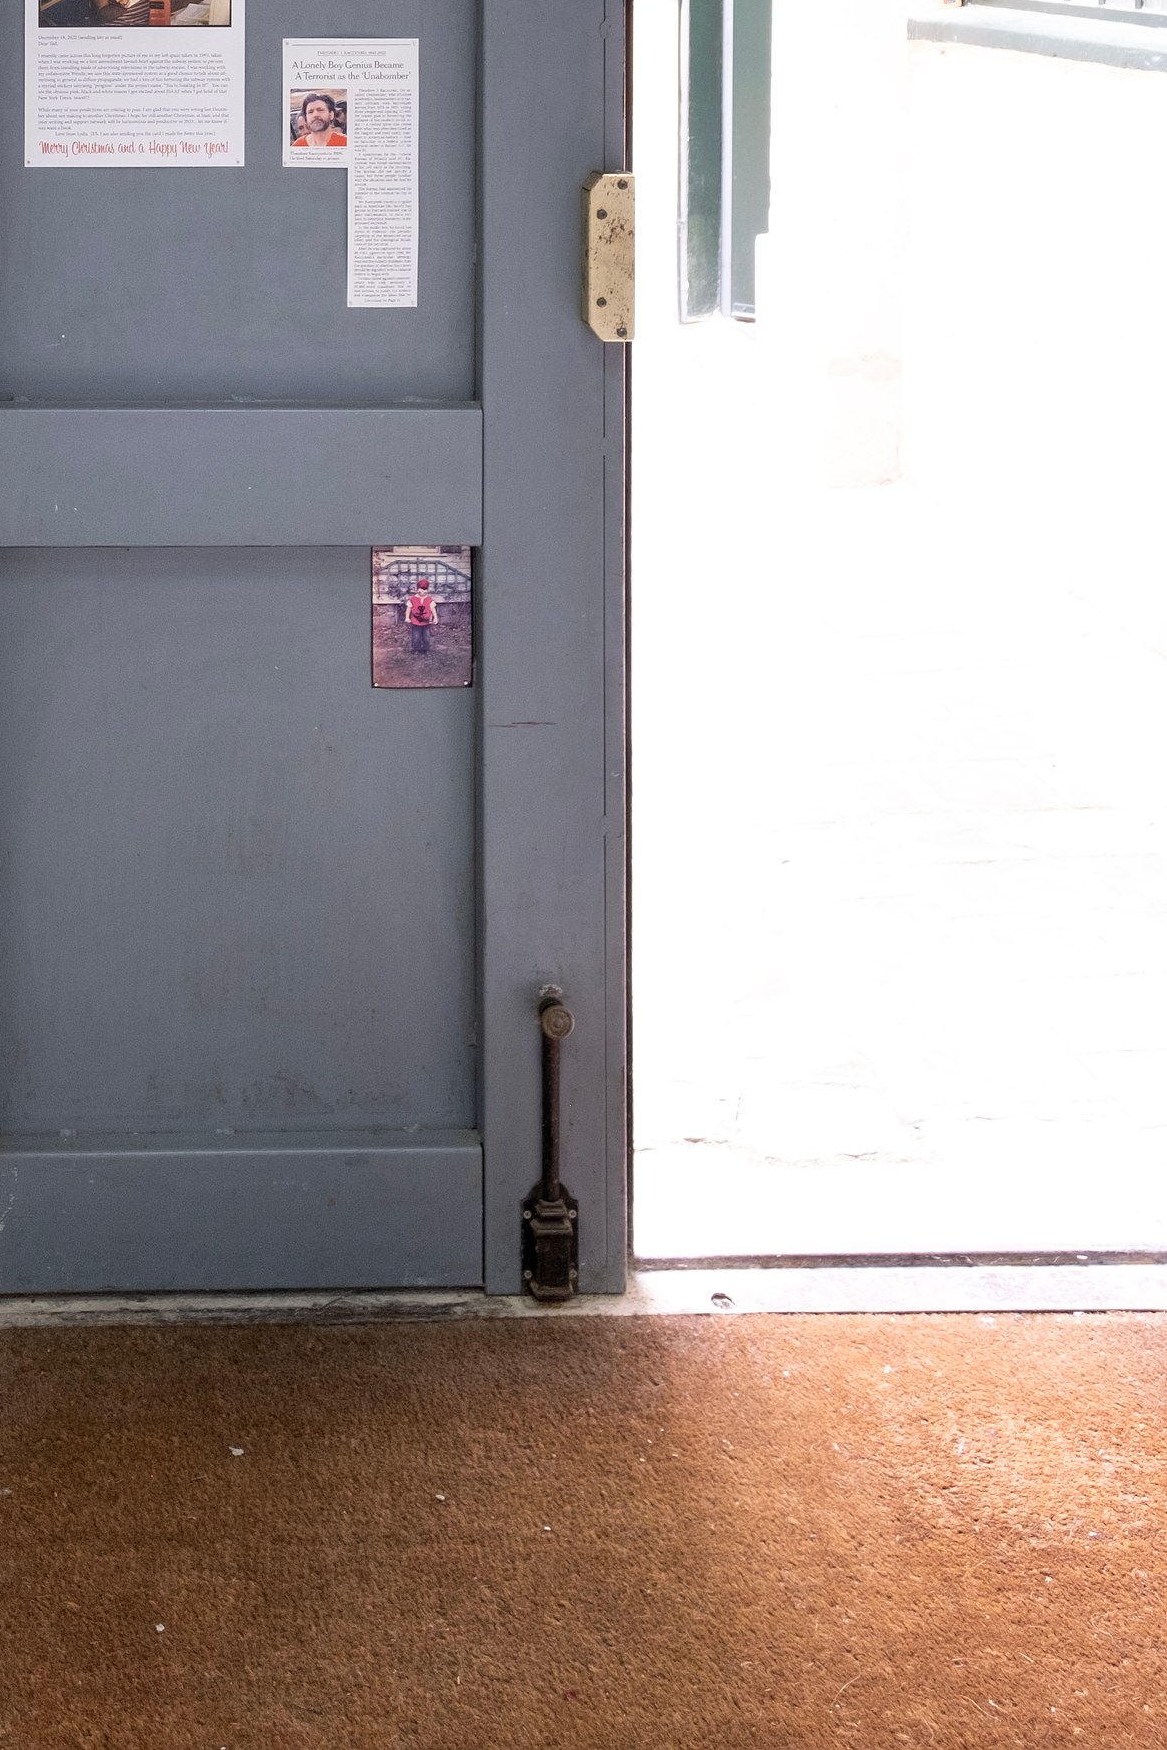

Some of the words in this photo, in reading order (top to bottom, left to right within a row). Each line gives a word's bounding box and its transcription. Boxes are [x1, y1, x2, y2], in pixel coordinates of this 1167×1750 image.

[292, 61, 299, 69] A
[300, 60, 327, 71] Lonely
[328, 60, 343, 71] Boy
[345, 60, 372, 69] Genius
[374, 60, 404, 69] Became
[295, 72, 302, 80] A
[303, 71, 336, 80] Terrorist
[348, 72, 360, 80] the
[39, 139, 69, 158] Merry
[71, 139, 115, 156] Christmas
[118, 140, 135, 155] and
[138, 144, 145, 155] a
[149, 139, 178, 158] Happy
[180, 140, 201, 155] New
[204, 140, 229, 159] Year!
